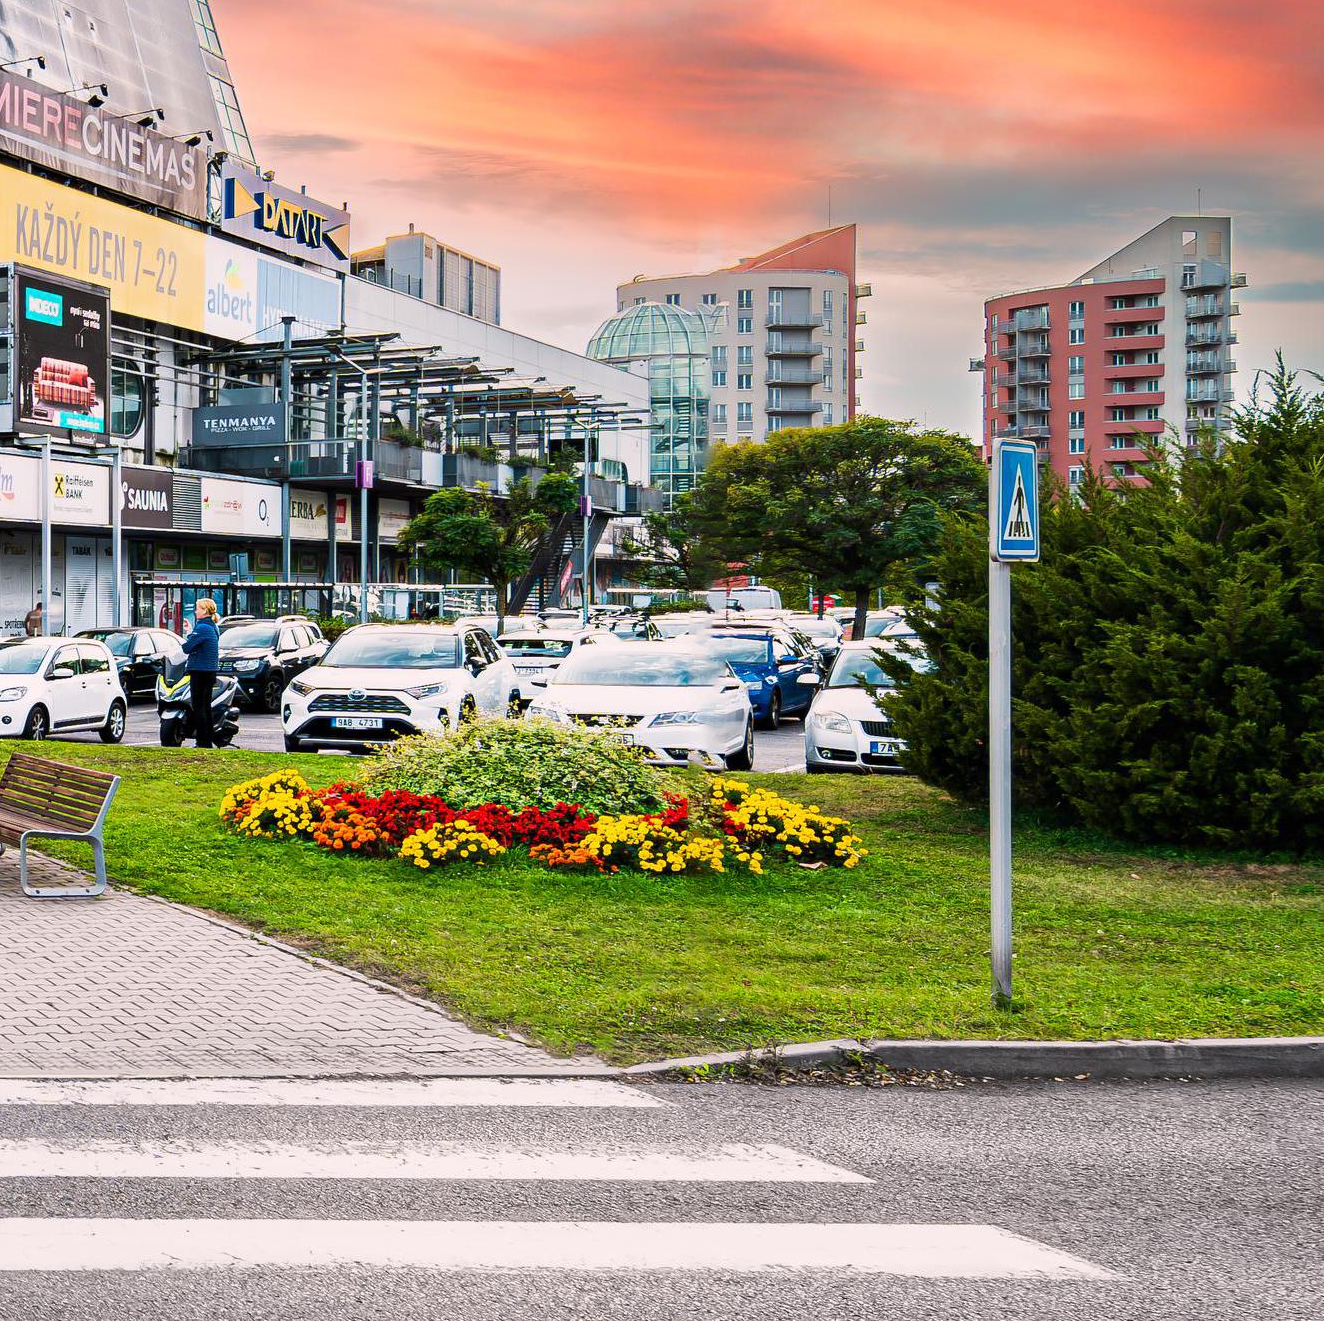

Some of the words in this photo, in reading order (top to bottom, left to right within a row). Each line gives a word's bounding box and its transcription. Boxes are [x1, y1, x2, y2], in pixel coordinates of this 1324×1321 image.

[260, 192, 330, 249] DATART
[16, 200, 82, 270] KAŽDÝ
[88, 226, 126, 283] DEN
[207, 282, 252, 325] albert
[203, 416, 276, 429] TENMANYA
[65, 489, 83, 500] BANK
[127, 488, 168, 512] SAUNIA
